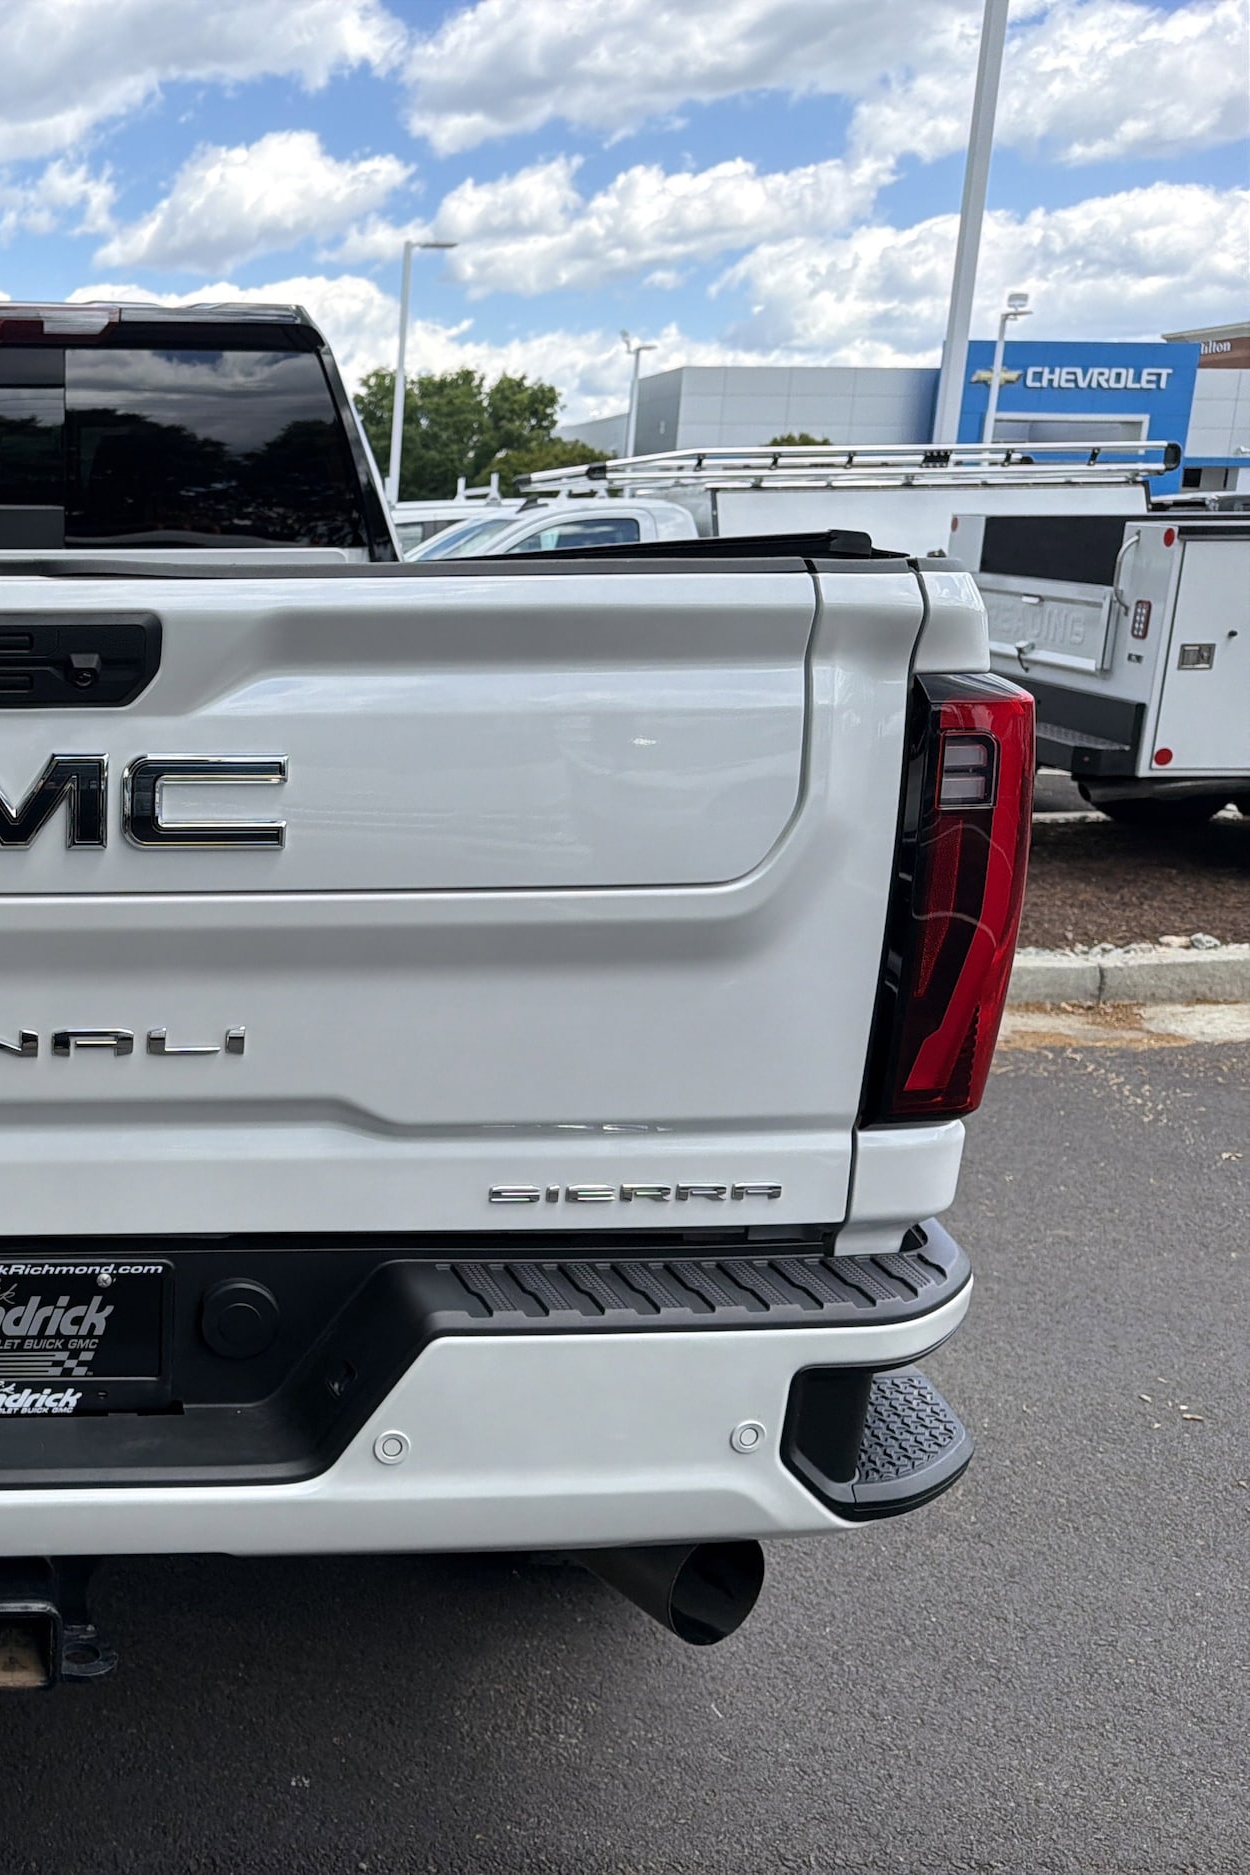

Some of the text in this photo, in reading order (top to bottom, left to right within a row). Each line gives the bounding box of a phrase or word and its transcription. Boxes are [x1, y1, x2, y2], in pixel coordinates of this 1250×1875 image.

[1026, 366, 1173, 390] CHEVROLET
[489, 1182, 782, 1203] SIERRA
[23, 1338, 65, 1350] BUICK
[67, 1338, 99, 1349] GMC
